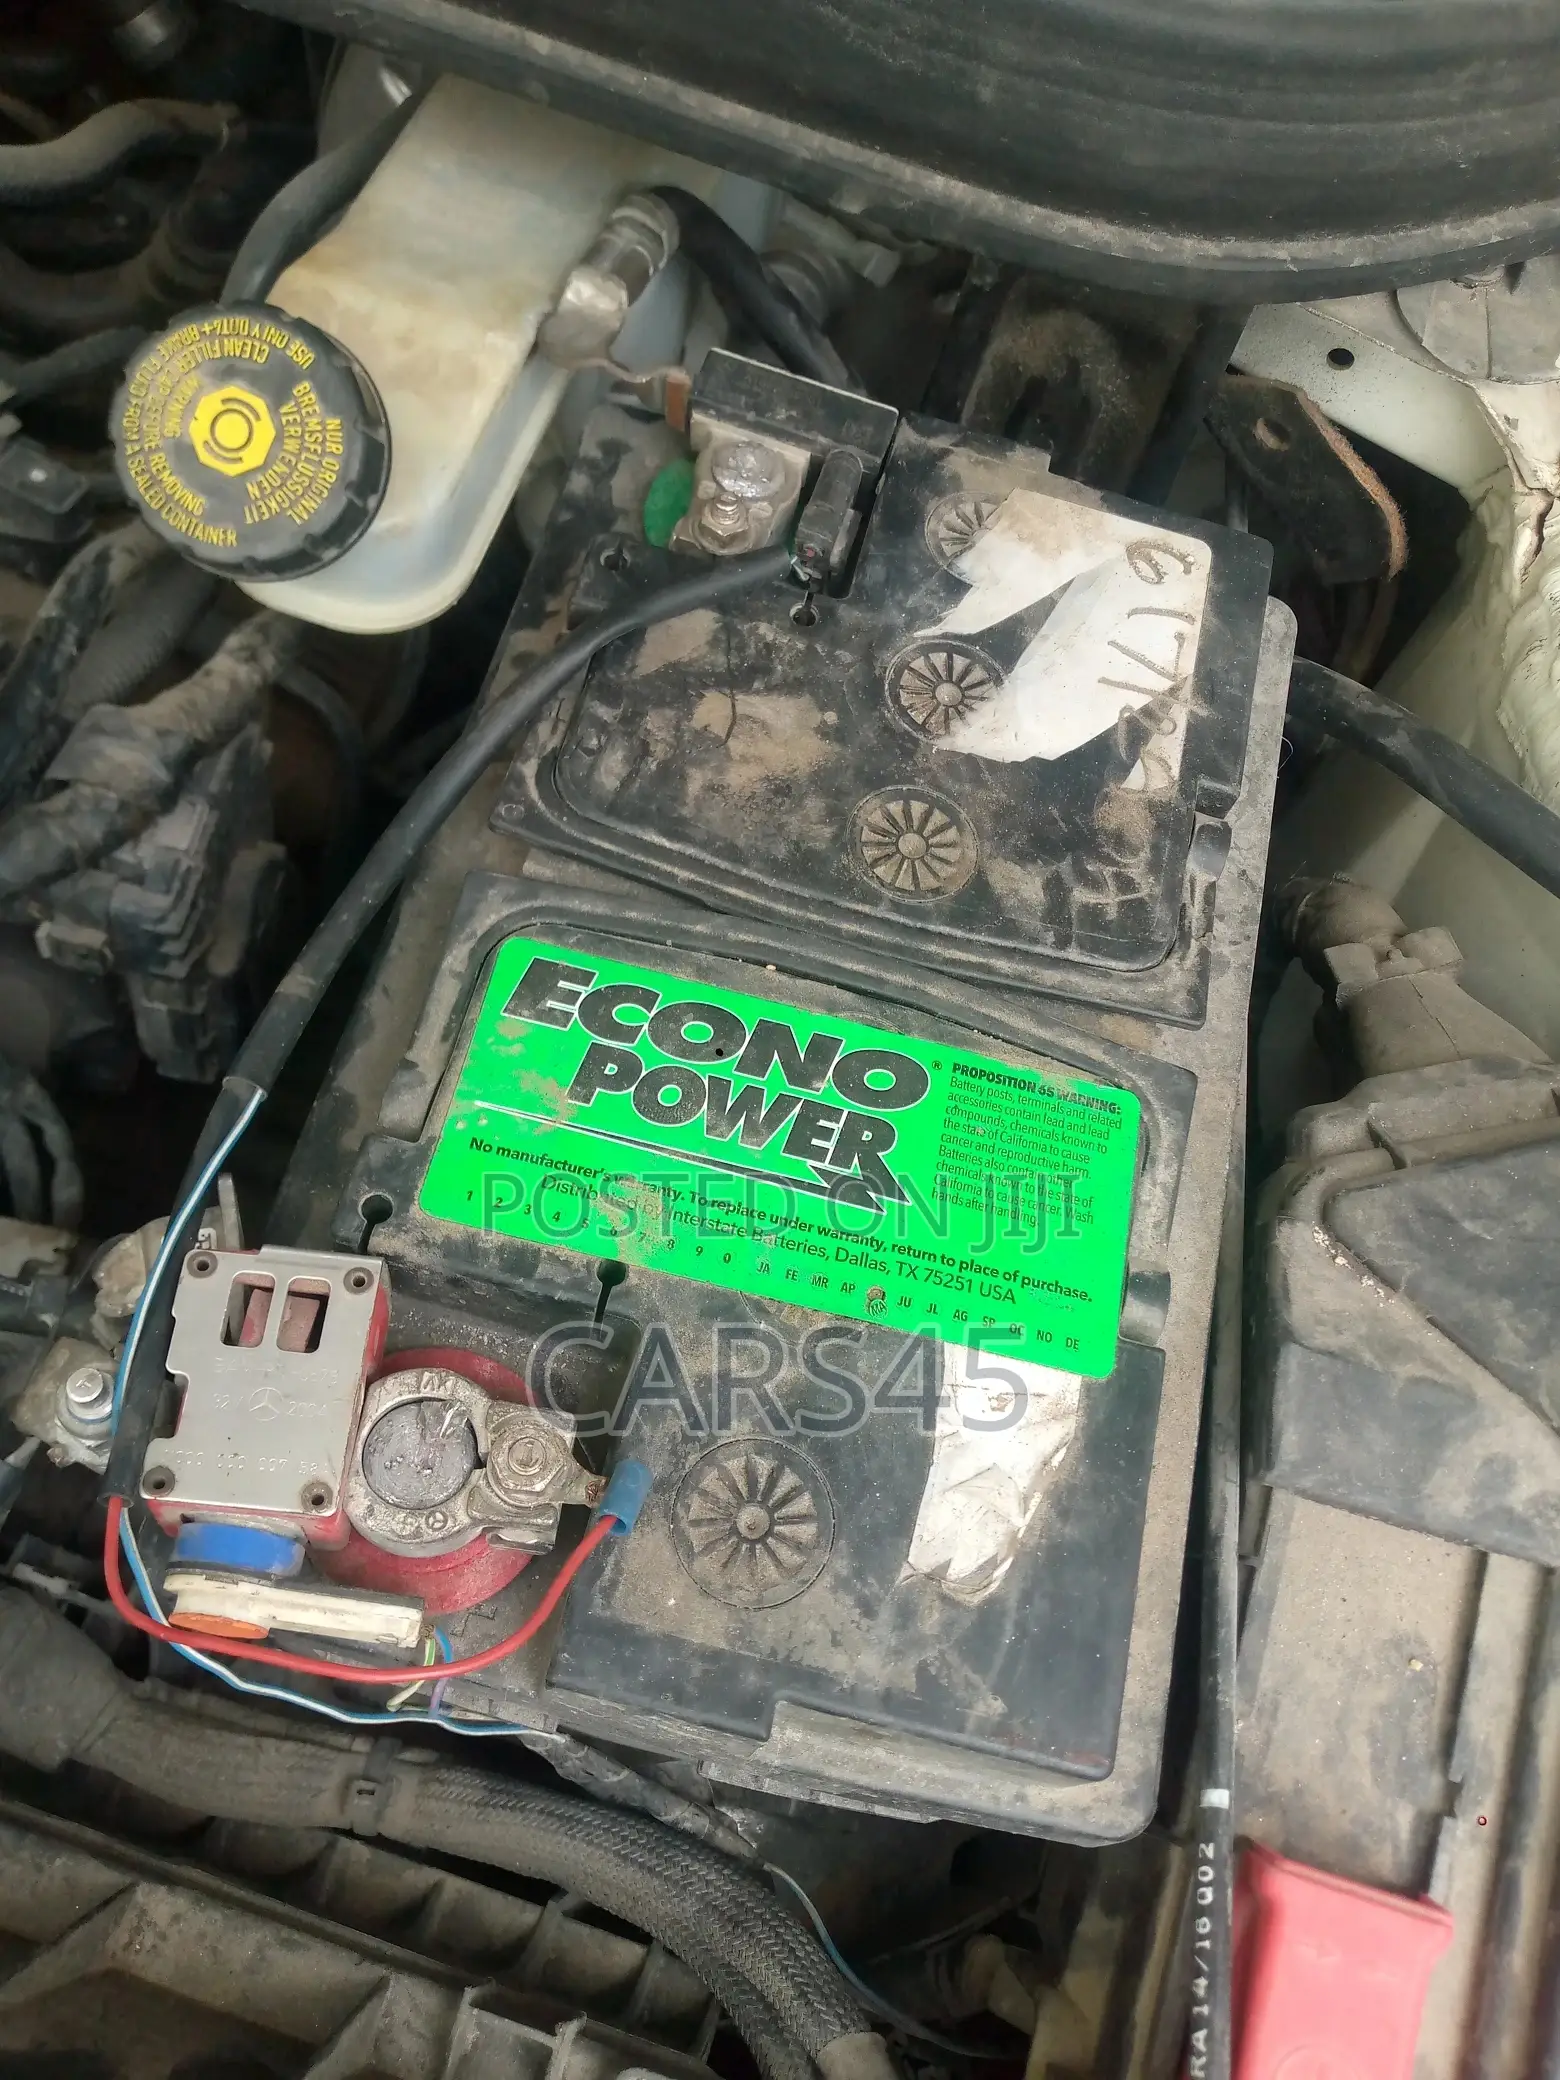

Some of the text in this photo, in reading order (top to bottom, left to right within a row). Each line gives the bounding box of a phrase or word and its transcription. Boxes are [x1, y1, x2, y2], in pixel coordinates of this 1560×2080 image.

[156, 323, 200, 362] BRAKE
[174, 338, 221, 375] FILLER
[223, 337, 270, 364] CLEAN
[286, 339, 316, 370] USE
[128, 355, 162, 397] FLUID
[122, 399, 143, 441] FROM
[325, 417, 344, 455] NUR
[124, 443, 142, 456] A
[245, 401, 302, 500] VERWENDEN
[127, 455, 166, 510] SEALED
[149, 452, 206, 517] REMOVING
[286, 456, 340, 526] ORIGINAL
[160, 504, 238, 548] CONTAINER
[500, 955, 930, 1112] ECONO
[950, 1076, 1122, 1130] Battery posts, terminals and related
[952, 1062, 1122, 1115] PROPOSITION 65 WARNING:
[565, 1040, 910, 1203] POWER
[943, 1117, 1090, 1164] the state of California to cause
[945, 1106, 1107, 1154] compounds, chemicals known to
[948, 1092, 1109, 1141] accessories contain lead and lead
[938, 1144, 1073, 1189] Batteries also contain other
[940, 1133, 1092, 1179] cancer and reproductive harm.
[932, 1187, 1040, 1228] hands after handling.
[934, 1173, 1094, 1225] California to cause cancer. Wash
[936, 1160, 1094, 1209] chemicals known to the state of
[469, 1136, 493, 1153] No
[496, 1146, 611, 1182] manufacturer's
[689, 1190, 708, 1207] To
[710, 1198, 767, 1222] replace
[769, 1213, 815, 1233] under
[817, 1226, 887, 1252] warranty,
[891, 1242, 937, 1263] return
[940, 1254, 956, 1267] to
[958, 1259, 1000, 1278] place
[1002, 1270, 1020, 1283] of
[1020, 1276, 1093, 1302] purchase.
[466, 1190, 474, 1201] 1
[494, 1197, 503, 1208] 2
[523, 1204, 532, 1215] 3
[552, 1210, 561, 1222] 4
[581, 1217, 590, 1229] 5
[638, 1231, 647, 1243] 7
[667, 1239, 675, 1250] 8
[695, 1245, 704, 1256] 9
[723, 1252, 732, 1264] 0
[756, 1261, 770, 1274] JA
[785, 1268, 798, 1281] FE
[811, 1274, 829, 1289] MR
[840, 1281, 856, 1294] AP
[870, 1300, 887, 1317] MA
[896, 1295, 912, 1308] JU
[926, 1302, 939, 1315] JL
[953, 1309, 968, 1322] AG
[982, 1315, 996, 1327] SP
[1009, 1323, 1025, 1336] OC
[1036, 1329, 1053, 1343] NO
[1066, 1337, 1080, 1350] DE
[669, 1203, 748, 1238] Interstate
[751, 1227, 830, 1261] Batteries,
[834, 1247, 891, 1275] Dallas,
[895, 1260, 919, 1281] TX
[923, 1267, 973, 1293] 75251
[979, 1281, 1017, 1305] USA
